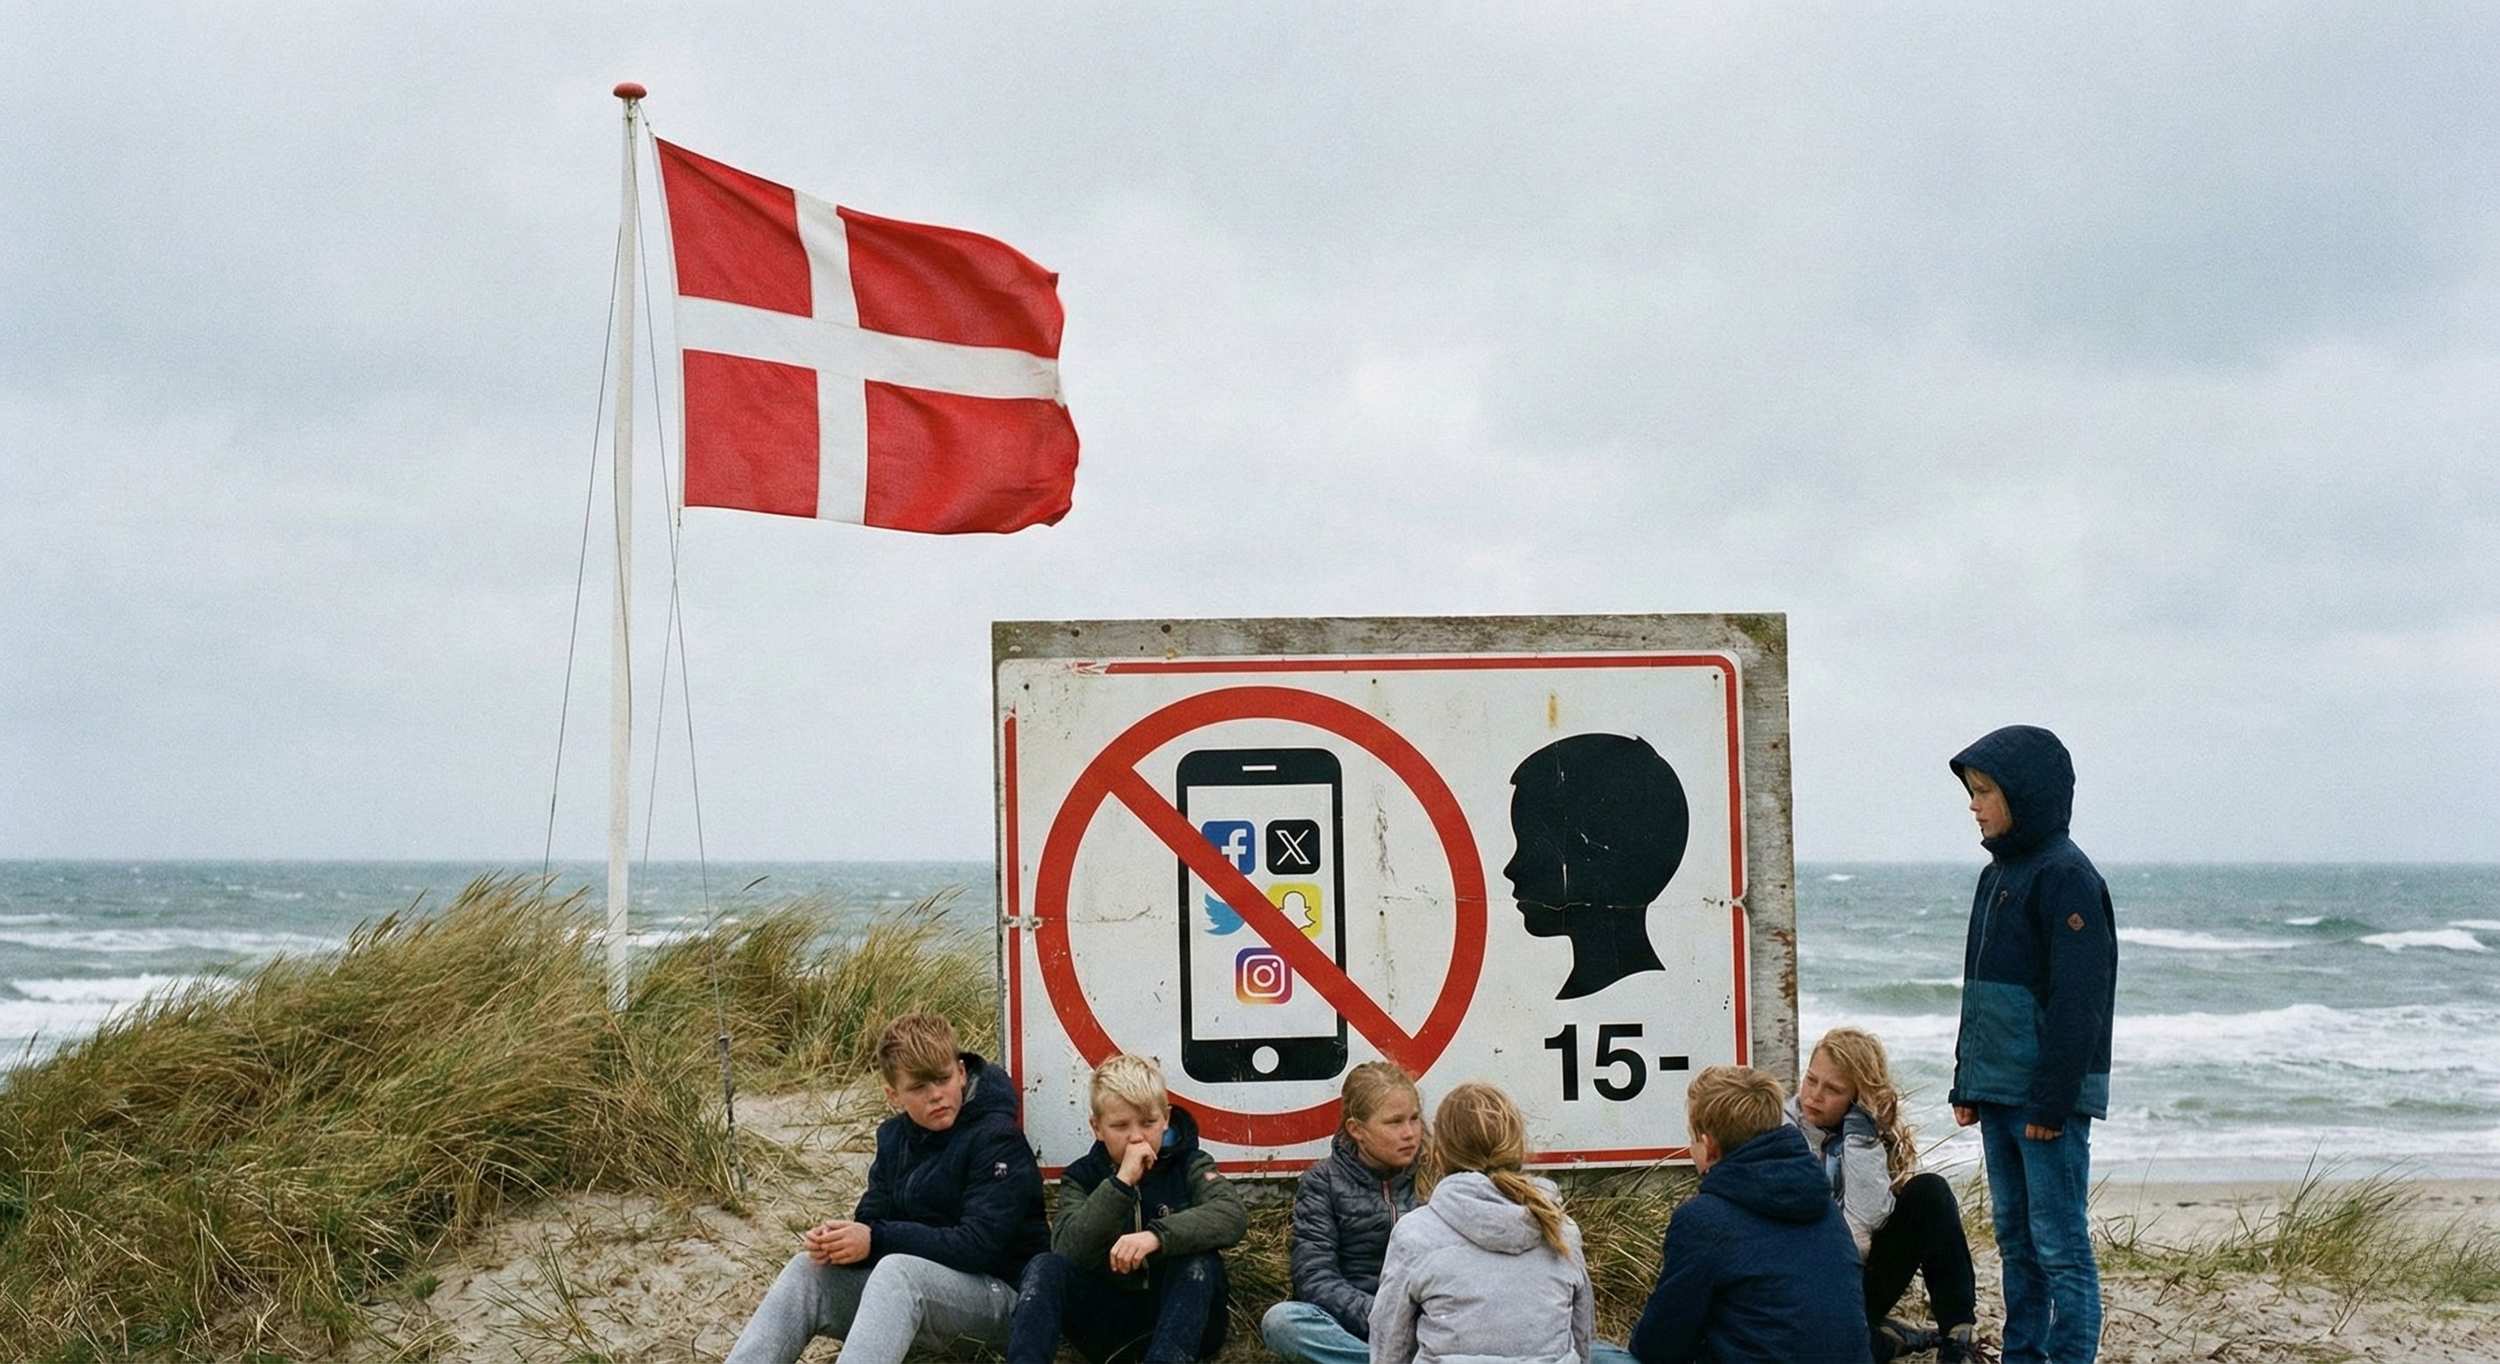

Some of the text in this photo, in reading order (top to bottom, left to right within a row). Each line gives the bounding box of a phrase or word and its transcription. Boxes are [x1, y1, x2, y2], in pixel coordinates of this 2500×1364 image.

[1221, 828, 1247, 871] f
[1275, 829, 1311, 866] X
[1544, 1023, 1690, 1102] 15-
